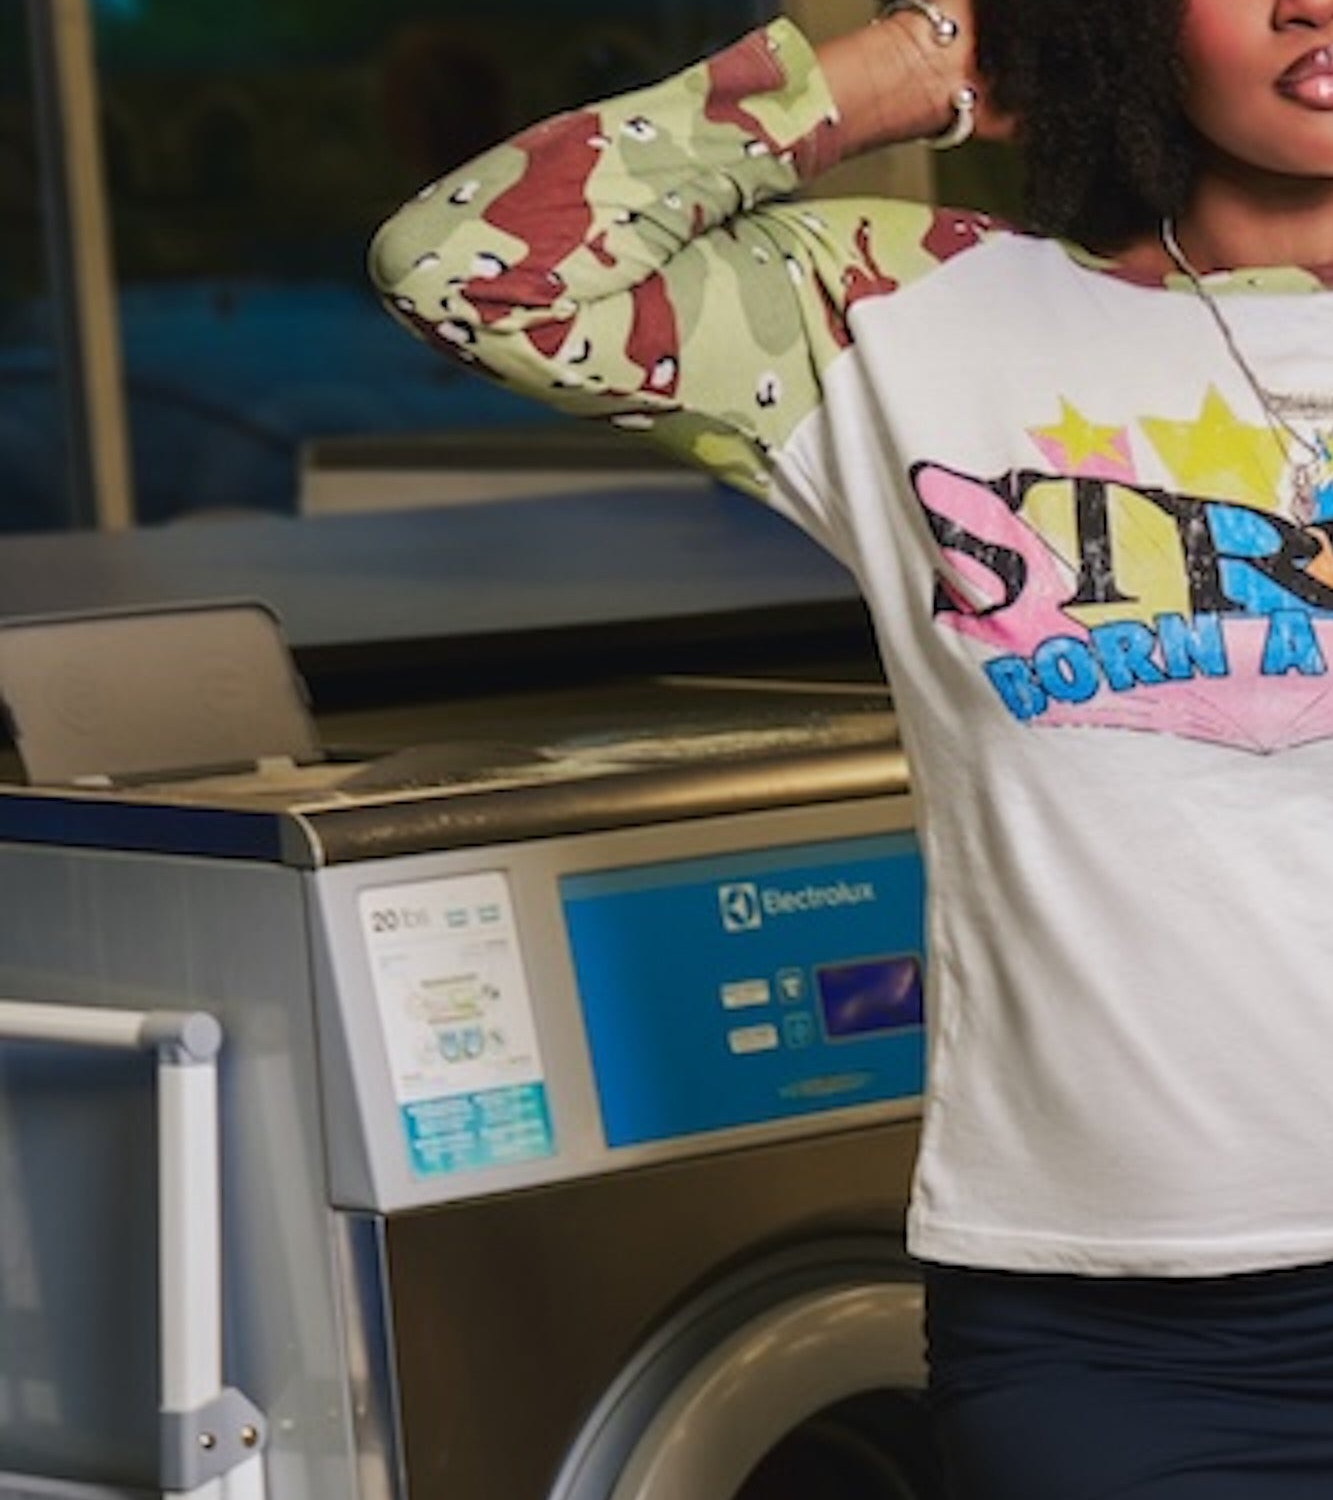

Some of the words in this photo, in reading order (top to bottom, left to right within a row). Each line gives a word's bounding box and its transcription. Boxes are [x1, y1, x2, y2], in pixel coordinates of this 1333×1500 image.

[985, 612, 1231, 723] BORN
[1260, 609, 1329, 677] A
[762, 880, 876, 915] Electrolux
[372, 909, 400, 933] 20
